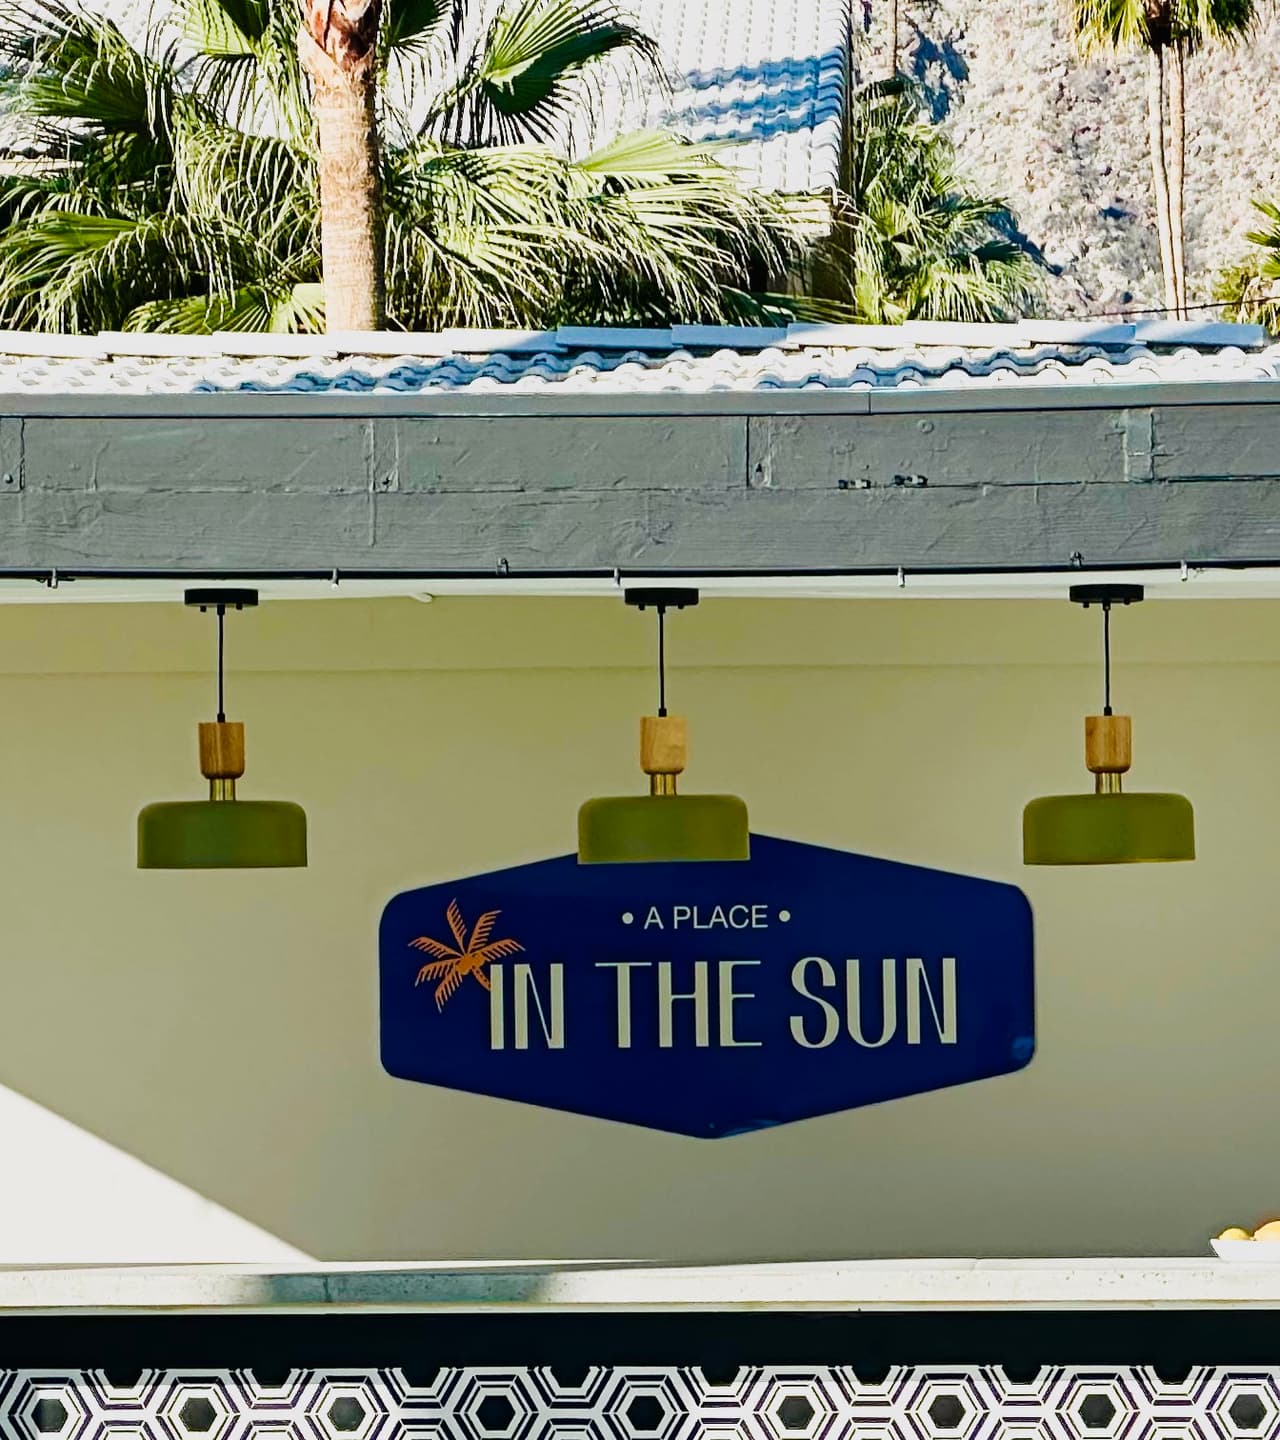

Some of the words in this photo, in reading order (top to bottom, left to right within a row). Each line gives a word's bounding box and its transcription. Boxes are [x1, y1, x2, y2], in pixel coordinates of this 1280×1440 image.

[643, 906, 665, 930] A
[673, 904, 770, 930] PLACE
[489, 963, 564, 1050] IN
[595, 959, 763, 1048] THE
[788, 956, 958, 1049] SUN
